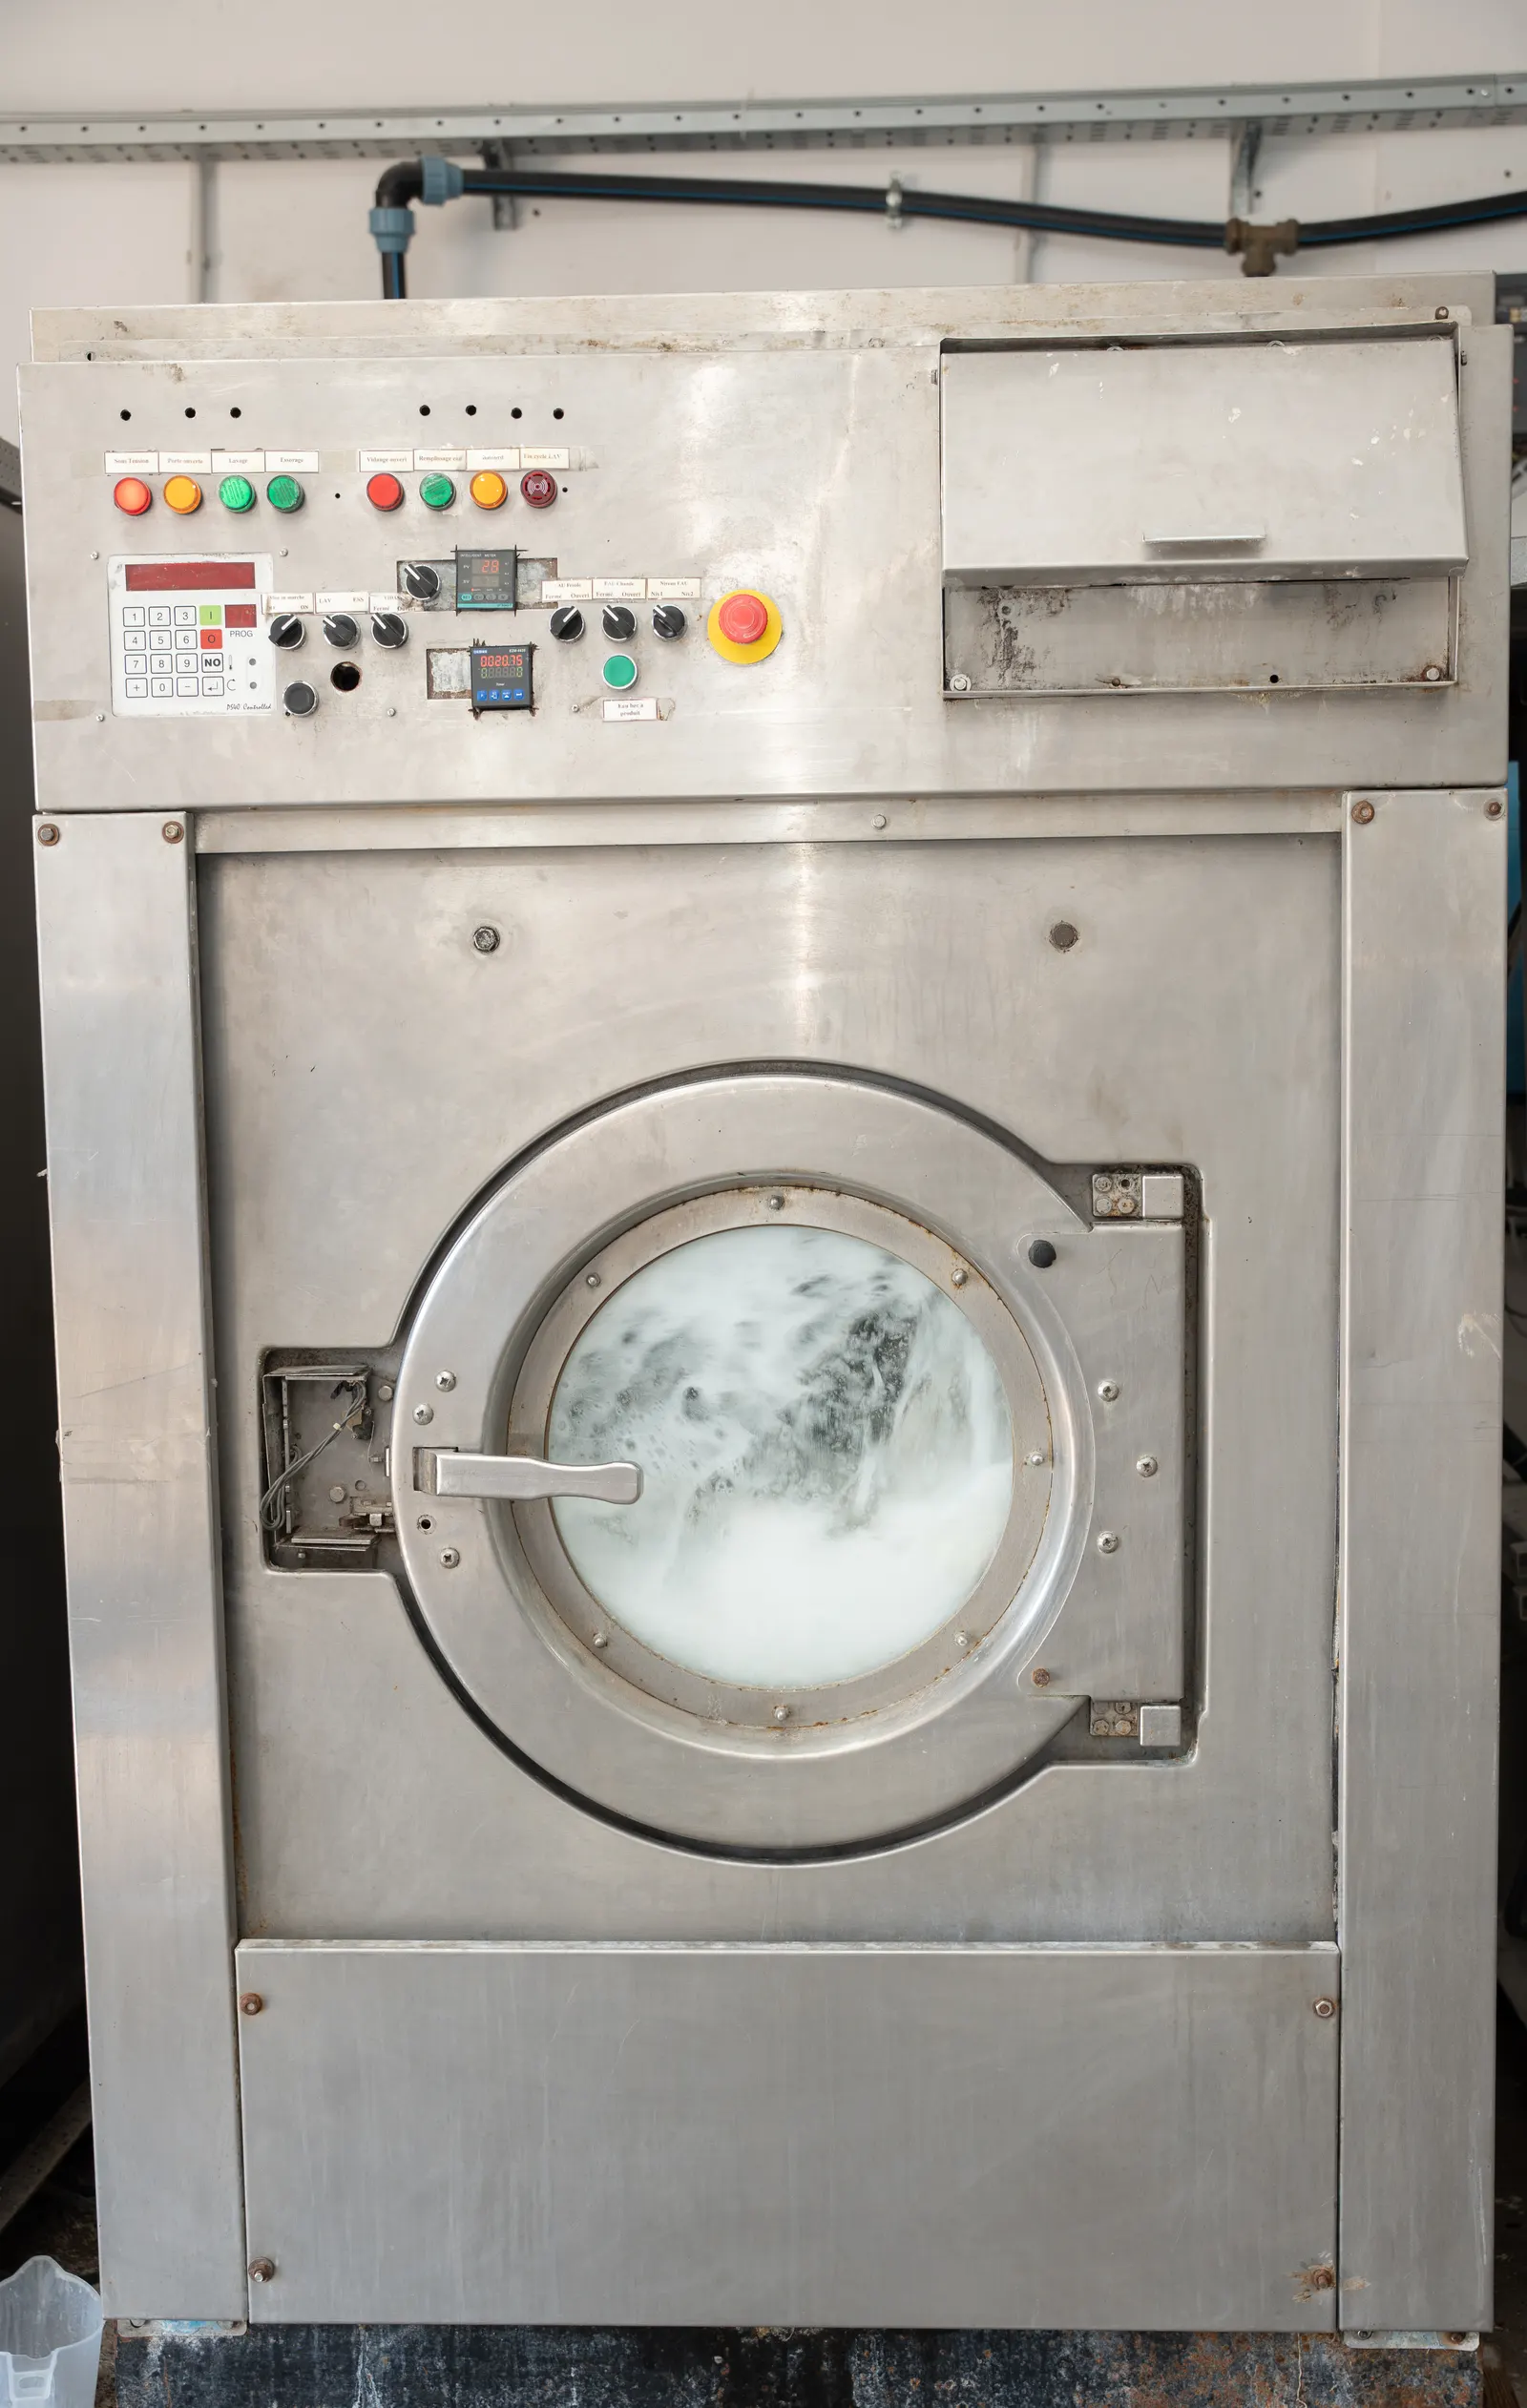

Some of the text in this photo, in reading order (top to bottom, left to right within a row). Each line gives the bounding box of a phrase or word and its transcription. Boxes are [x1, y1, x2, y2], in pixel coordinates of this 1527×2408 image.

[482, 559, 499, 573] 28
[132, 613, 136, 621] 1
[157, 612, 163, 620] 2
[182, 611, 189, 620] 3
[157, 636, 164, 644] 5
[182, 635, 190, 644] 6
[133, 660, 139, 668] 7
[158, 660, 165, 668] 8
[183, 659, 191, 668] 9
[204, 659, 221, 667] NO
[158, 682, 166, 692] 0
